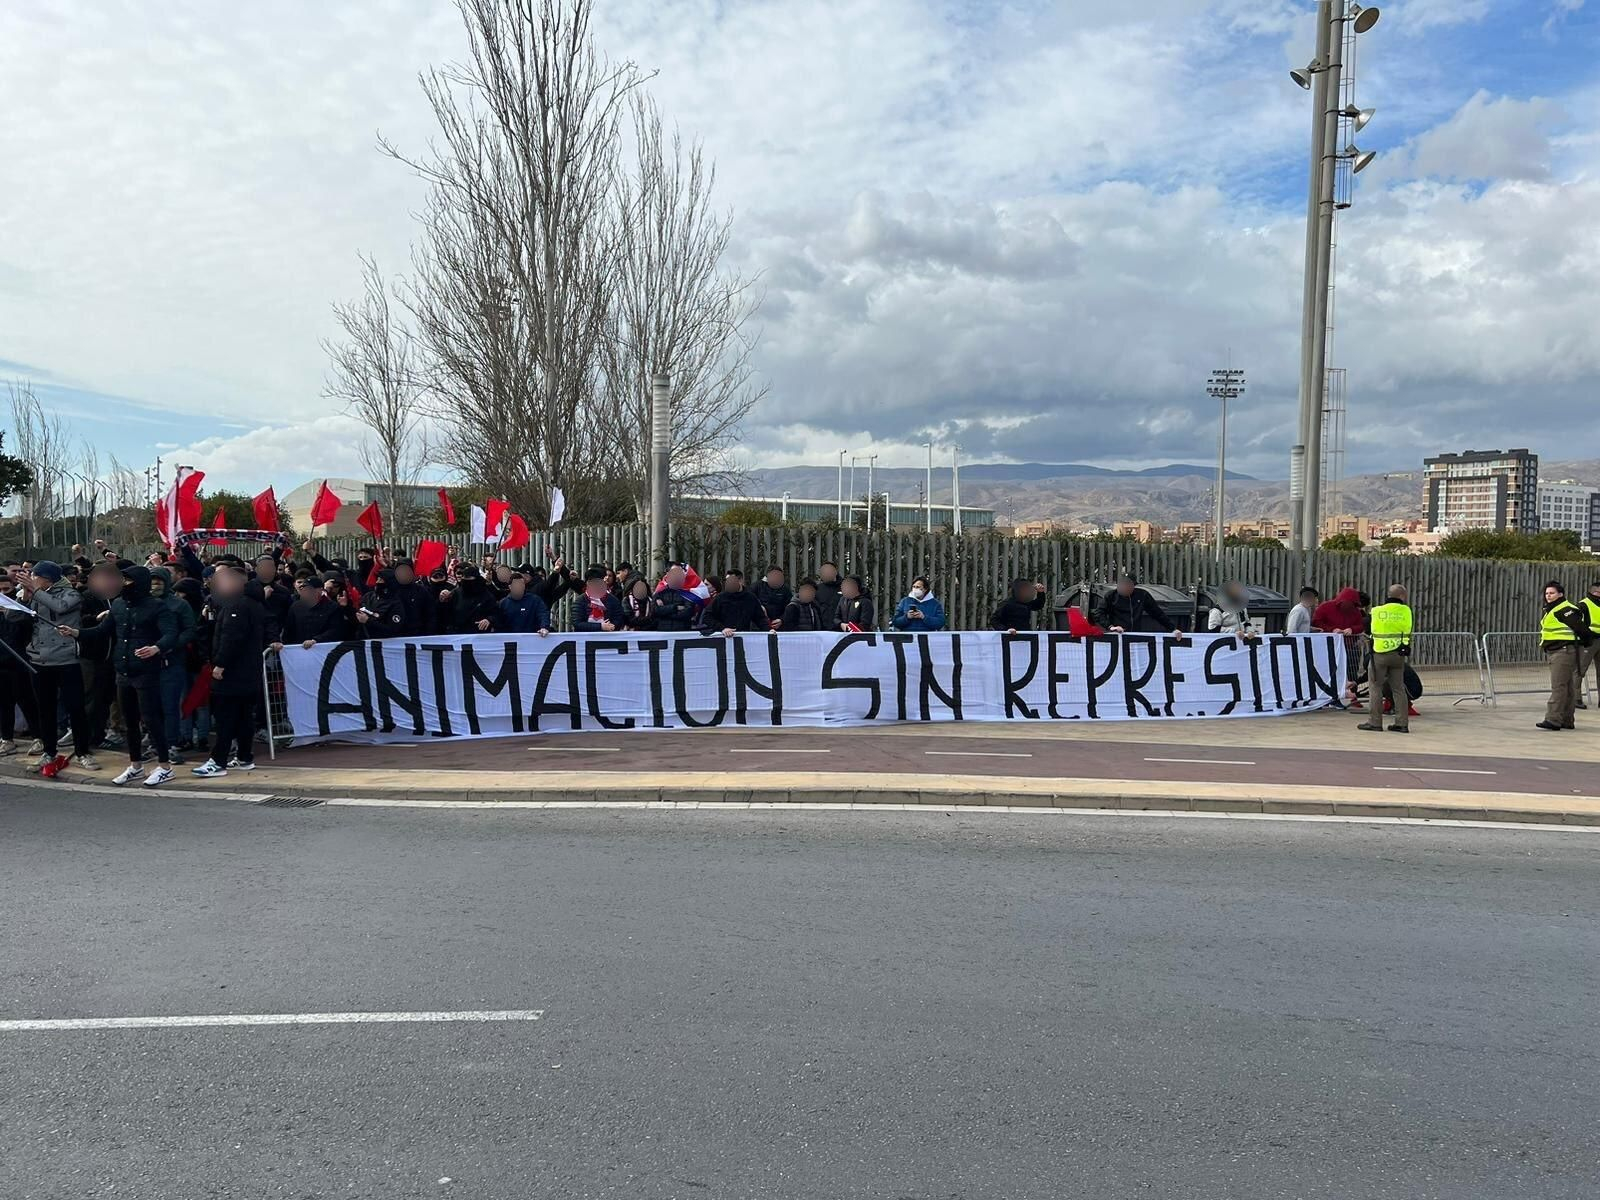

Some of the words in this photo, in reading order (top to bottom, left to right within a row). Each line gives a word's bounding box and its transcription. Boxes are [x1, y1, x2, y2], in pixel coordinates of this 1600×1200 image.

[317, 634, 783, 738] ANIMACION
[821, 633, 964, 721] SIN
[1001, 634, 1339, 719] REPRESION
